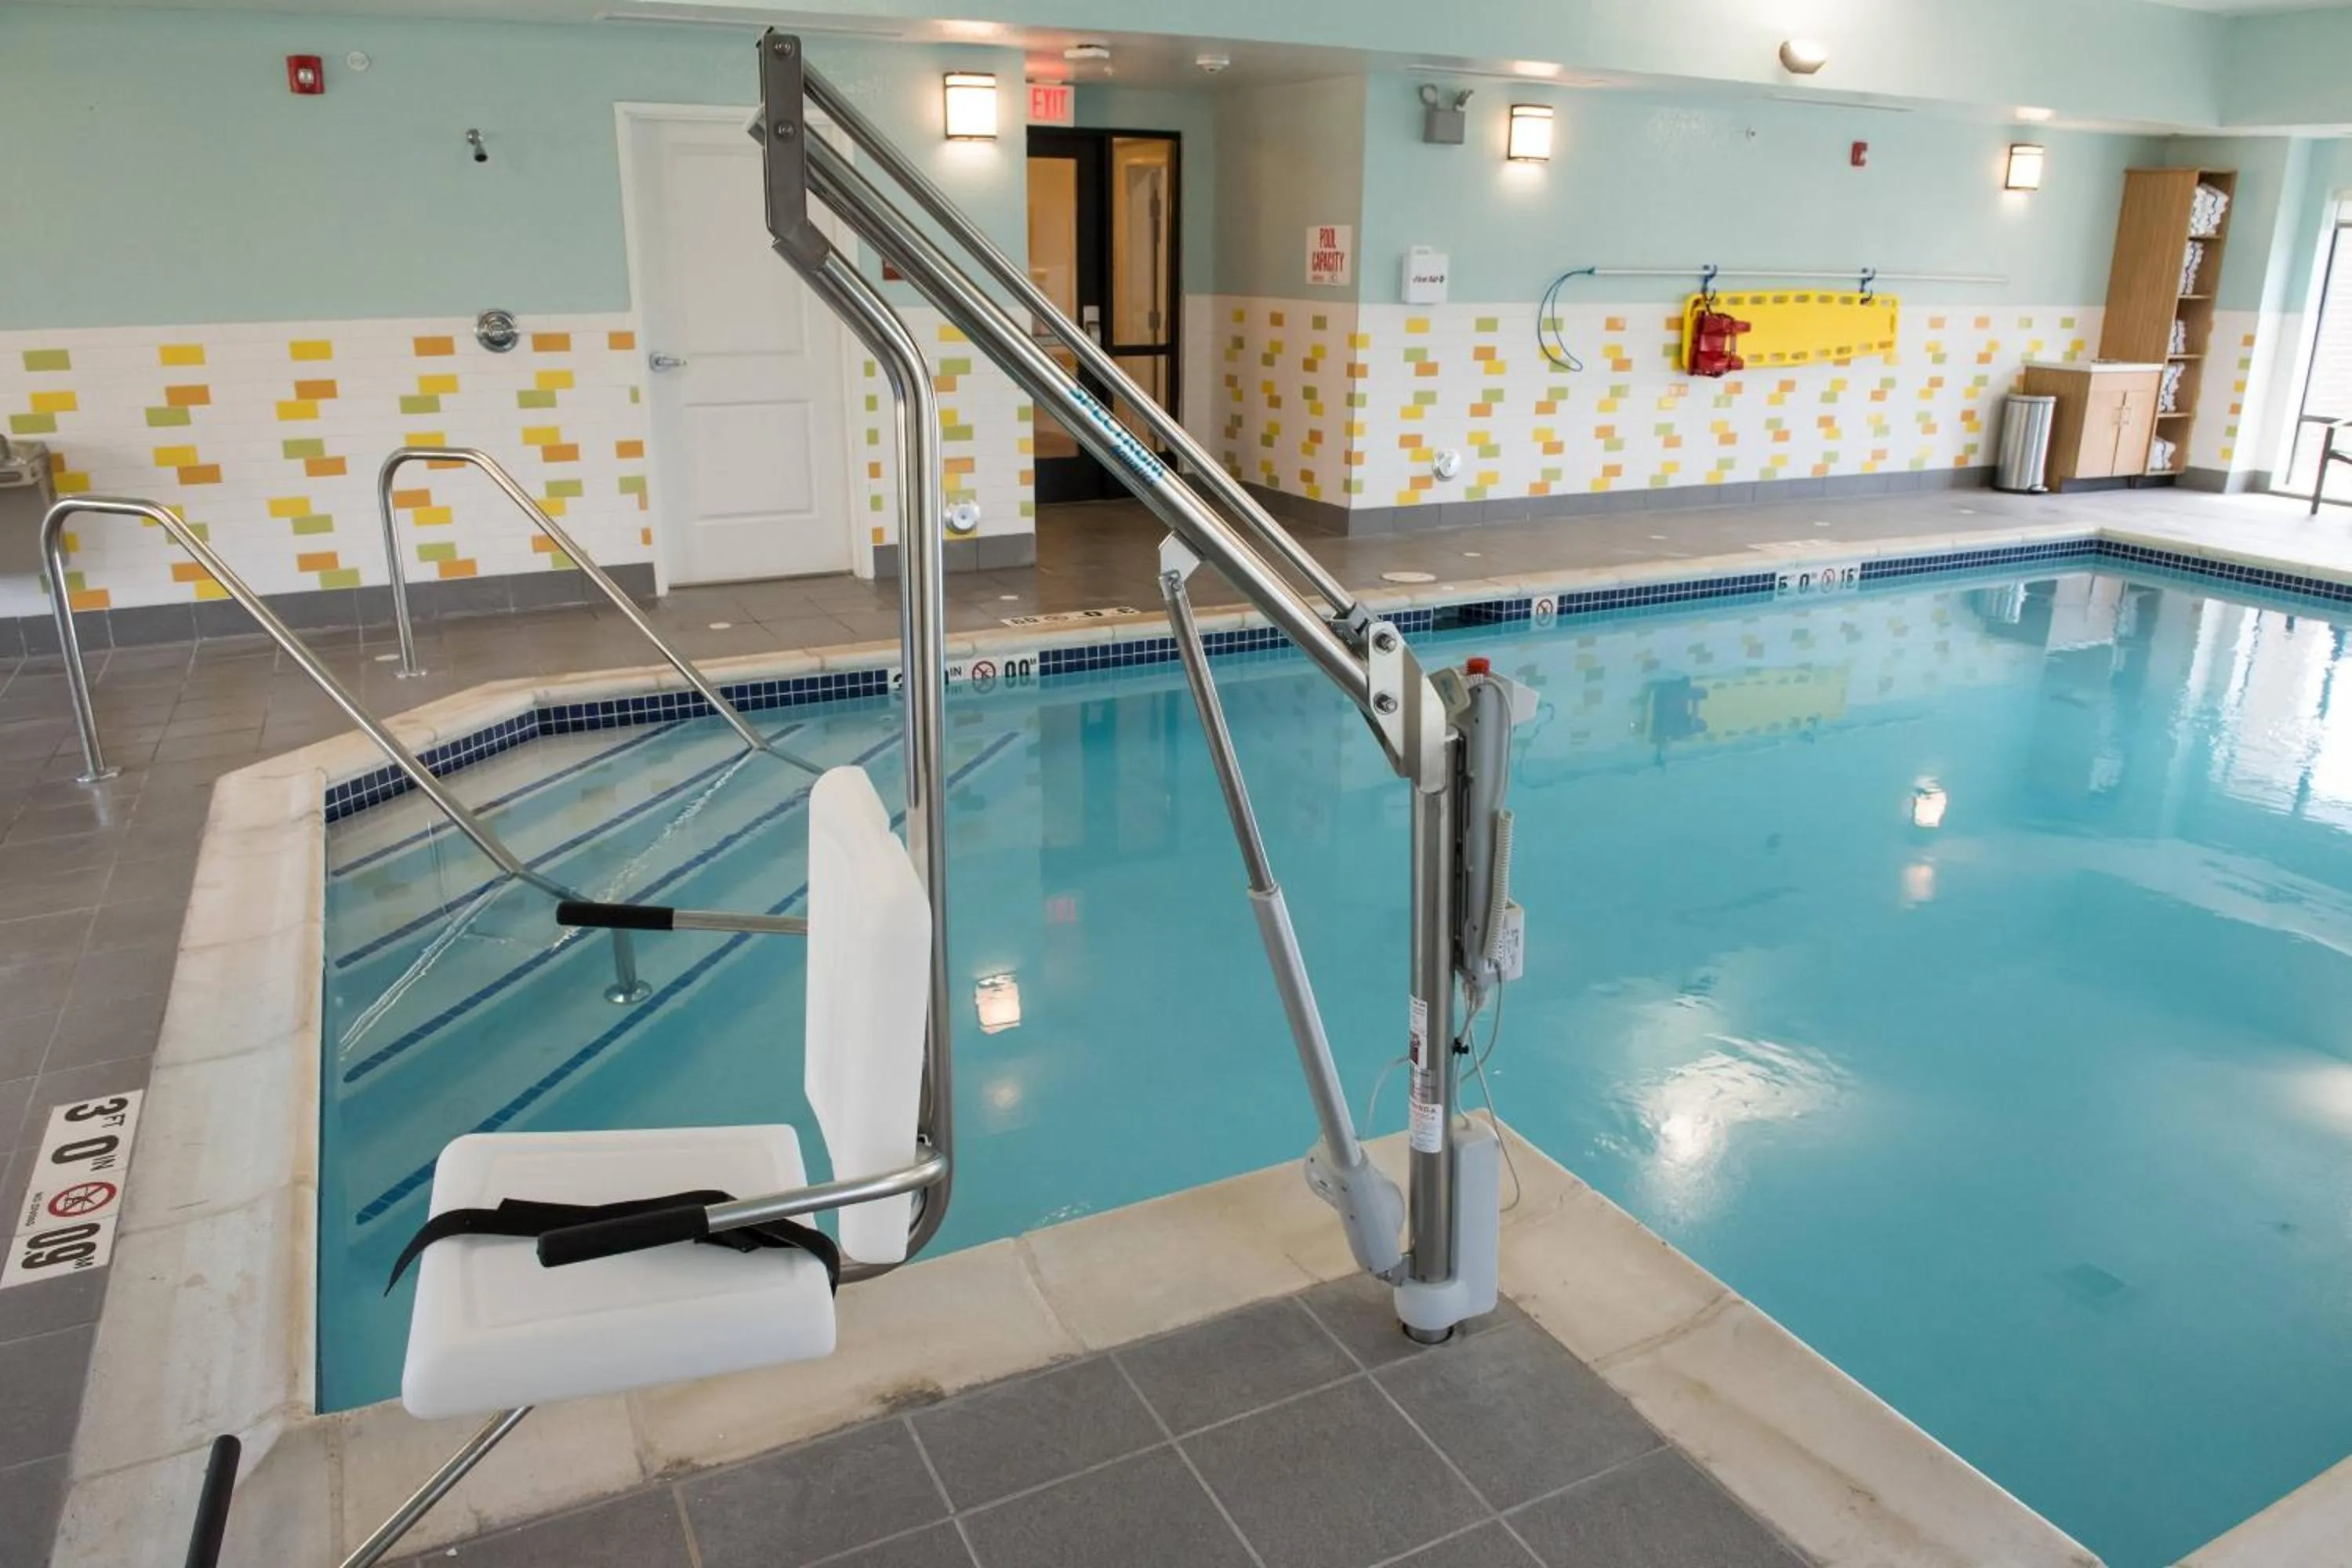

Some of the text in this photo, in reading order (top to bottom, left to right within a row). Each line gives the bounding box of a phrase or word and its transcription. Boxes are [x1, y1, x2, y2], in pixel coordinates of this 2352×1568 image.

[1033, 87, 1067, 122] EXIT
[1319, 227, 1336, 249] POOL
[1312, 251, 1345, 272] CAPACITY
